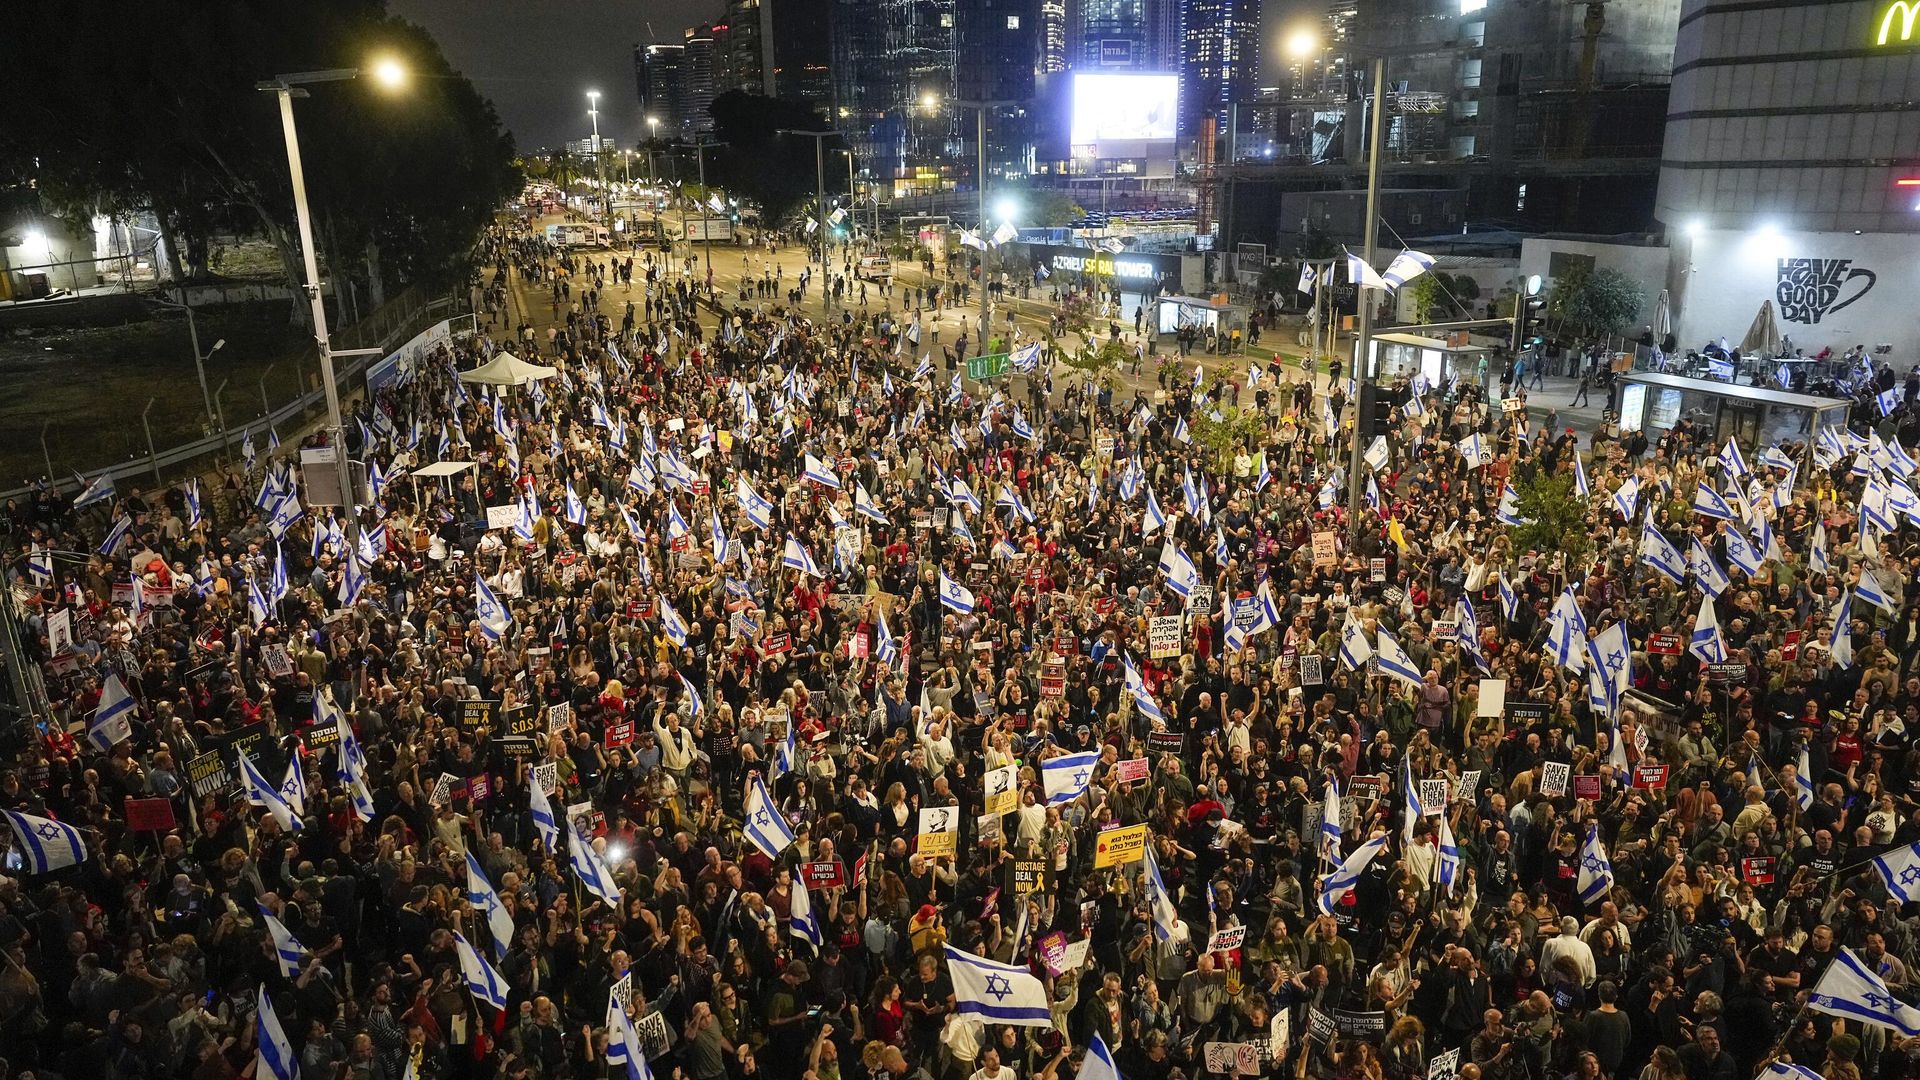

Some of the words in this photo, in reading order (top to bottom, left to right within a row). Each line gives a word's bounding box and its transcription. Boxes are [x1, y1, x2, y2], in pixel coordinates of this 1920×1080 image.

[1115, 262, 1152, 278] TOWER
[1777, 281, 1839, 308] GOOD
[1781, 305, 1831, 324] DAY
[1302, 657, 1318, 665] SAVE
[1303, 664, 1319, 672] THEM
[1303, 671, 1320, 679] FROM
[551, 704, 567, 714] SAVE
[464, 717, 479, 725] NOW
[511, 718, 534, 735] S.O.S
[310, 726, 337, 739] עסקה
[190, 760, 219, 782] HOME
[536, 765, 554, 777] SAVE
[1546, 764, 1566, 775] SAVE
[1544, 773, 1564, 782] THEM
[194, 769, 226, 798] NOW!
[1422, 781, 1444, 791] SAVE
[1542, 780, 1563, 791] FROM
[1423, 790, 1444, 801] THEM
[1424, 798, 1444, 808] FROM
[925, 835, 949, 845] 7/10
[1015, 862, 1046, 872] HOSTAGE
[1015, 873, 1033, 881] DEAL
[1015, 882, 1033, 891] NOW
[638, 1017, 661, 1034] SAVE
